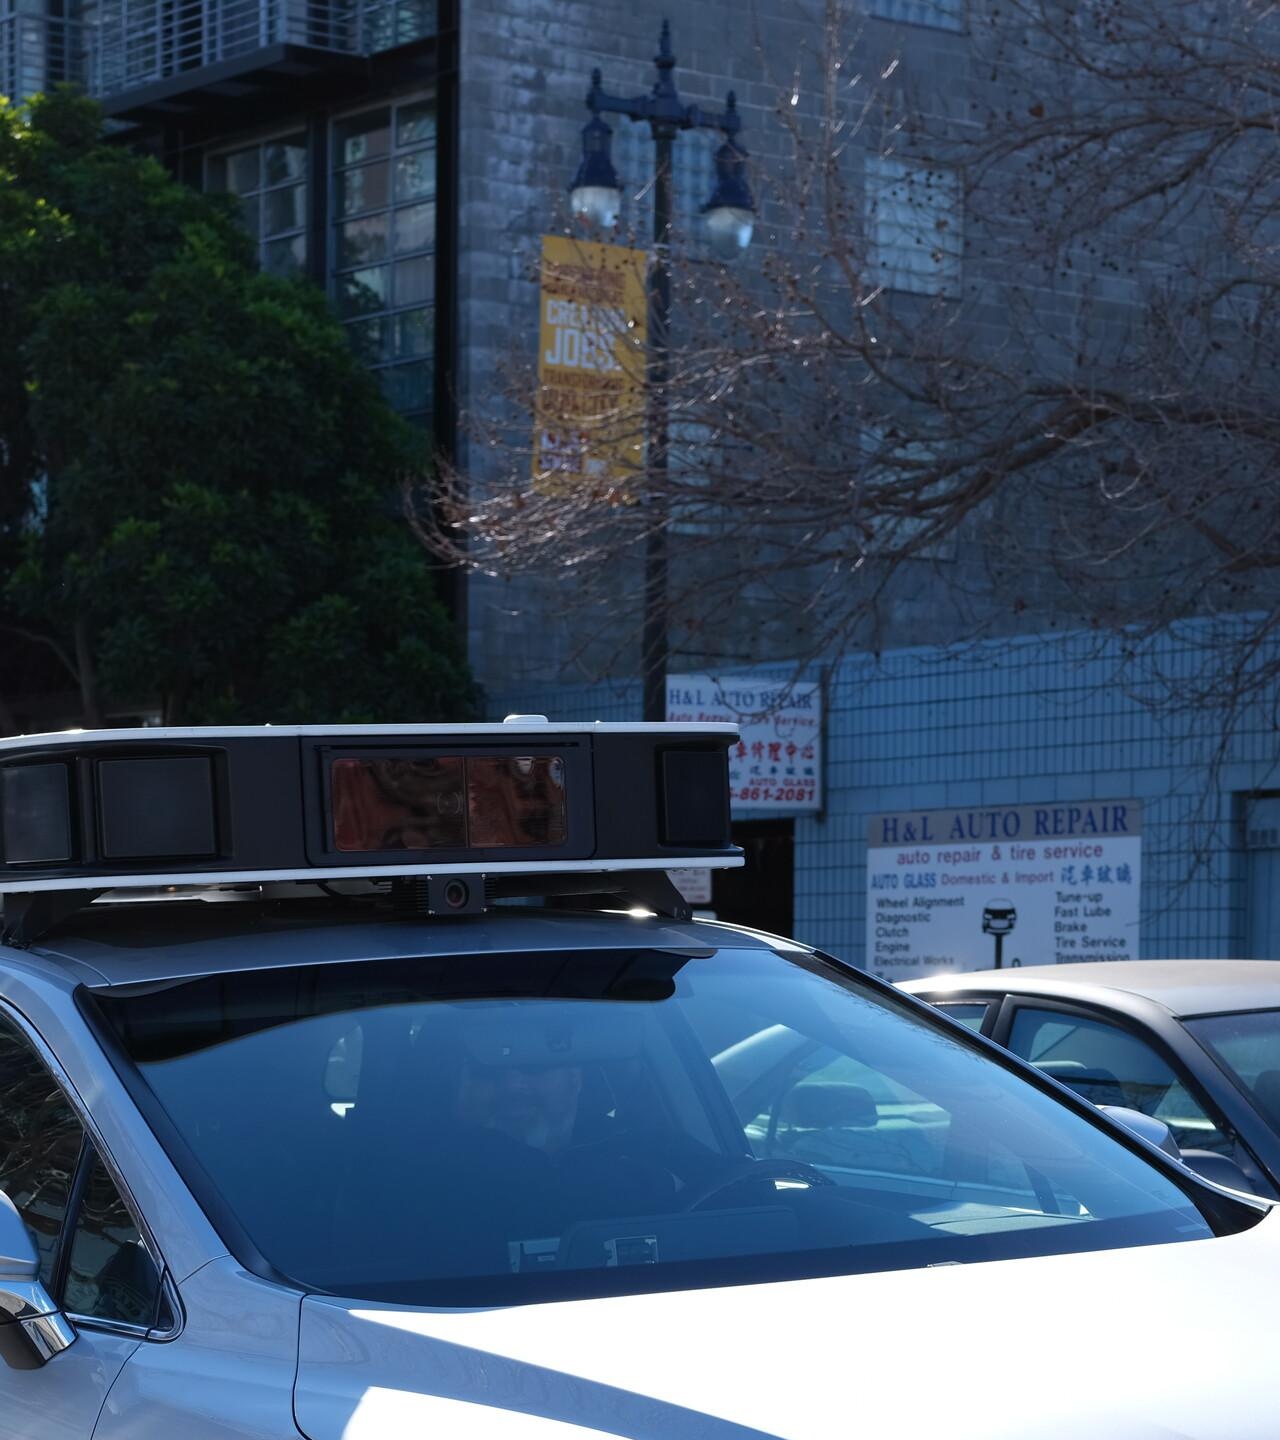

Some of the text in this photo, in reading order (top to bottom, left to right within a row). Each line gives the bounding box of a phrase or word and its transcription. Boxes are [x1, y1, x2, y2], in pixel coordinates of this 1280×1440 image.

[545, 328, 621, 373] JOBS
[711, 691, 754, 708] AUTO
[749, 777, 816, 786] AUTO GLASS
[730, 787, 815, 801] -861-2081
[881, 805, 1129, 844] H&L AUTO REPAIR
[896, 841, 1104, 866] auto repair & tire service
[870, 872, 937, 889] AUTO GLASS
[941, 873, 996, 886] Domestic
[1001, 872, 1010, 884] &
[876, 896, 965, 910] Wheel Alignment
[1055, 891, 1103, 905] Tune-up
[875, 911, 931, 925] Diagnostic
[1054, 905, 1112, 918] Fast Lube
[875, 927, 909, 938] Clutch
[1054, 921, 1087, 933] Brake
[874, 942, 910, 954] Engine
[1055, 935, 1126, 948] Tire Service
[874, 955, 955, 967] Electrical Works
